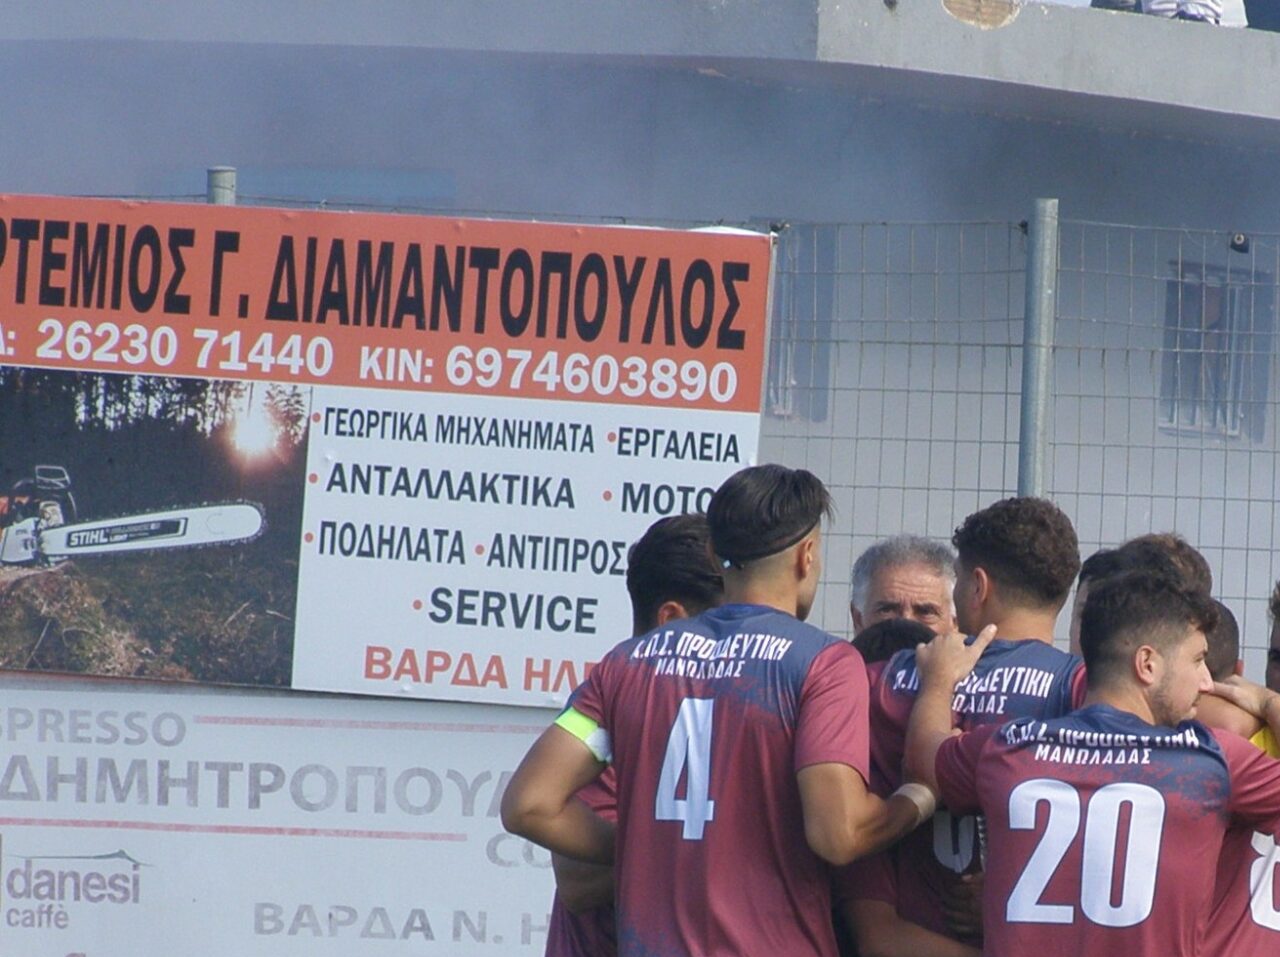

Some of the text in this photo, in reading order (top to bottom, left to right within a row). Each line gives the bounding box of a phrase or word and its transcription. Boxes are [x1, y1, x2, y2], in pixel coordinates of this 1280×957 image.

[0, 217, 750, 350] ΤΕΜΙΟΣ Γ. ΔΙΑΜΑΝΤΟΠΟΥΛΟΣ
[36, 318, 178, 367] 26230
[193, 328, 334, 377] 71440
[359, 346, 433, 384] ΚΙΝ:
[446, 345, 738, 403] 6974603890
[323, 406, 741, 464] ΓΕΩΡΓΙΚΑ ΜΗΧΑΝΗΜΑΤΑ ΕΡΓΑΛΕΙΑ
[325, 462, 576, 510] ΑΝΤΑΛΛΑΚΤΙΚΑ
[69, 527, 110, 546] STIHL
[318, 520, 466, 566] ΠΟΔΗΛΑΤΑ
[427, 586, 599, 634] SERVICE
[363, 645, 509, 690] ΒΑΡΔΑ
[0, 707, 187, 748] PRESSO
[655, 697, 715, 840] 4
[1034, 744, 1152, 765] ΜΑΝΩΛΑΔΑΣ
[1006, 778, 1166, 928] 20
[6, 859, 140, 904] danesi
[6, 903, 70, 930] caffè
[252, 902, 435, 942] ΒΑΡΔΑ
[452, 910, 504, 944] Ν.
